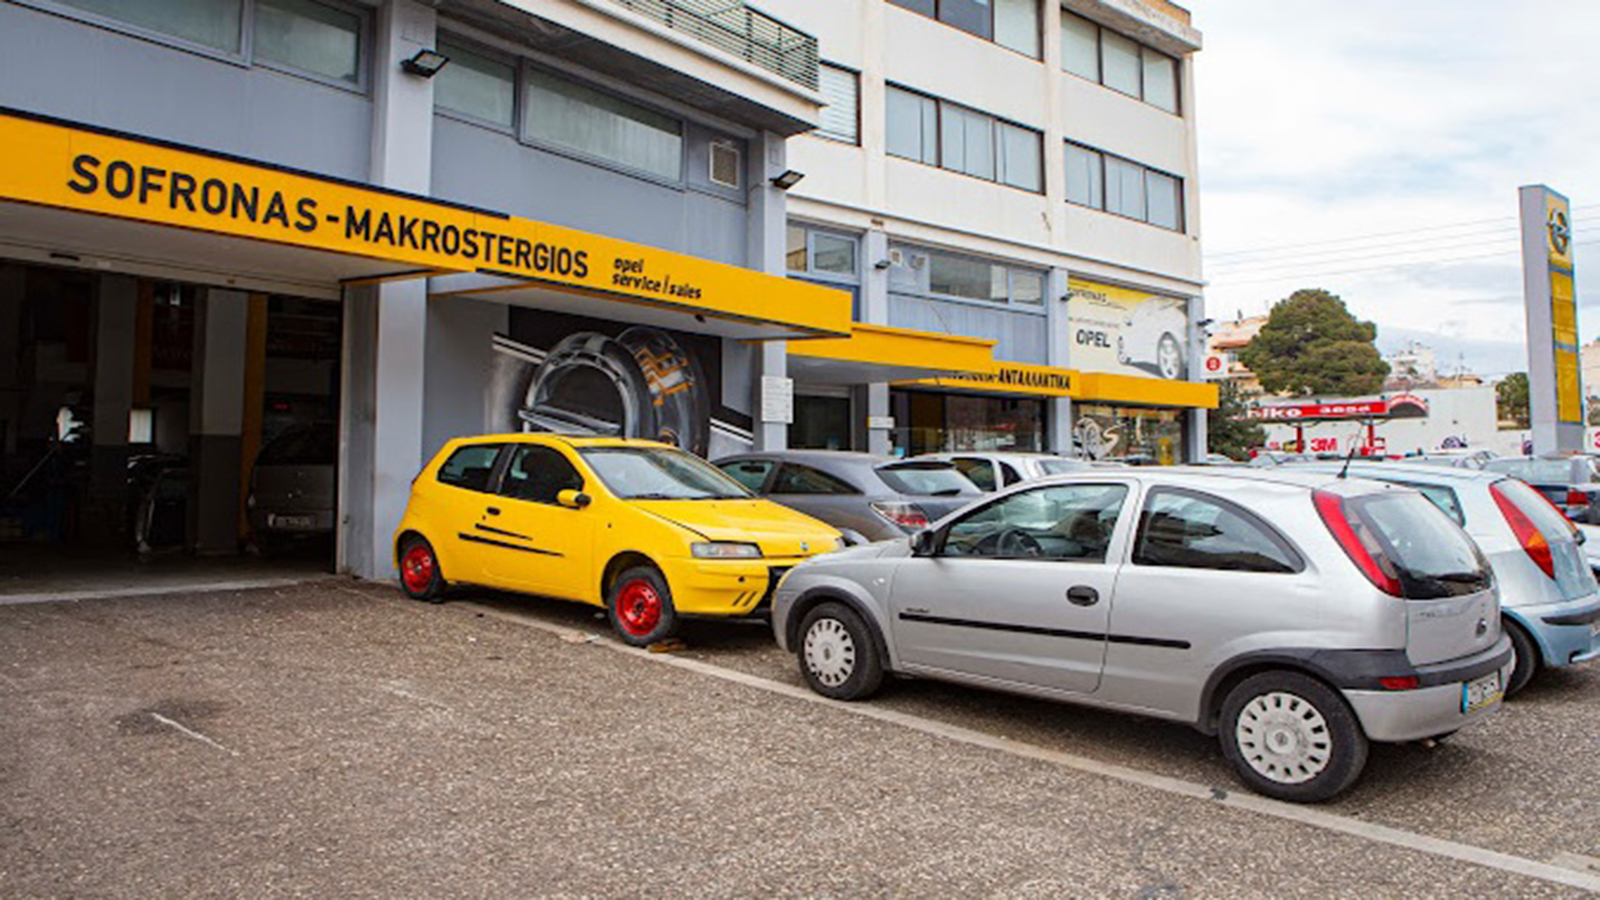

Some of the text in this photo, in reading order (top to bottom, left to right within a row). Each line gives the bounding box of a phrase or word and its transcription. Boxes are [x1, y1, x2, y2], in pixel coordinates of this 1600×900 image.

[614, 258, 644, 273] opel
[1076, 328, 1111, 348] OPEL
[1310, 437, 1338, 453] 3M
